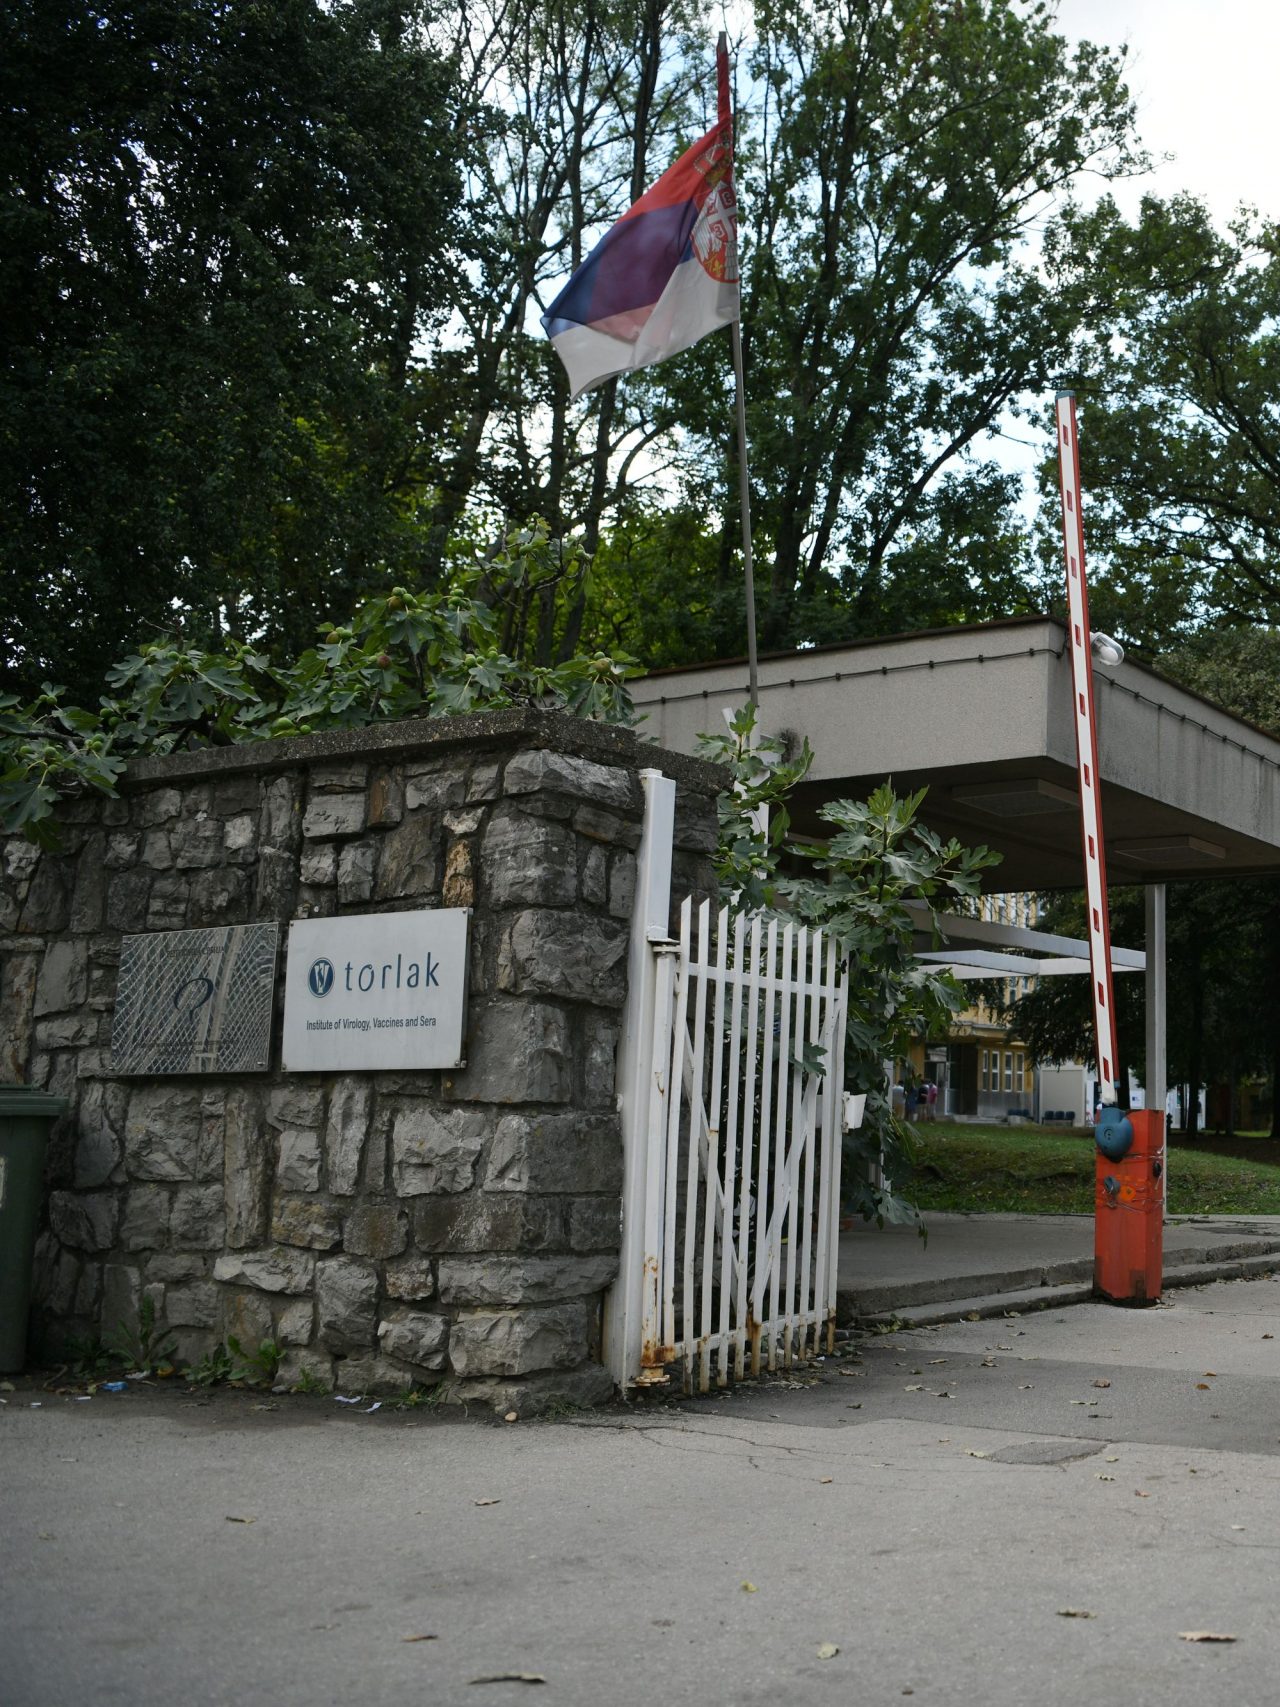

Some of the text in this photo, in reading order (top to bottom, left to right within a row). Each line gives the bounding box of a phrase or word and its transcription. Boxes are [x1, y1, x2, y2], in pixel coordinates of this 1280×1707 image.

[345, 951, 440, 992] torlak
[306, 1015, 437, 1031] Institute of Virology, Vaccines and Sera
